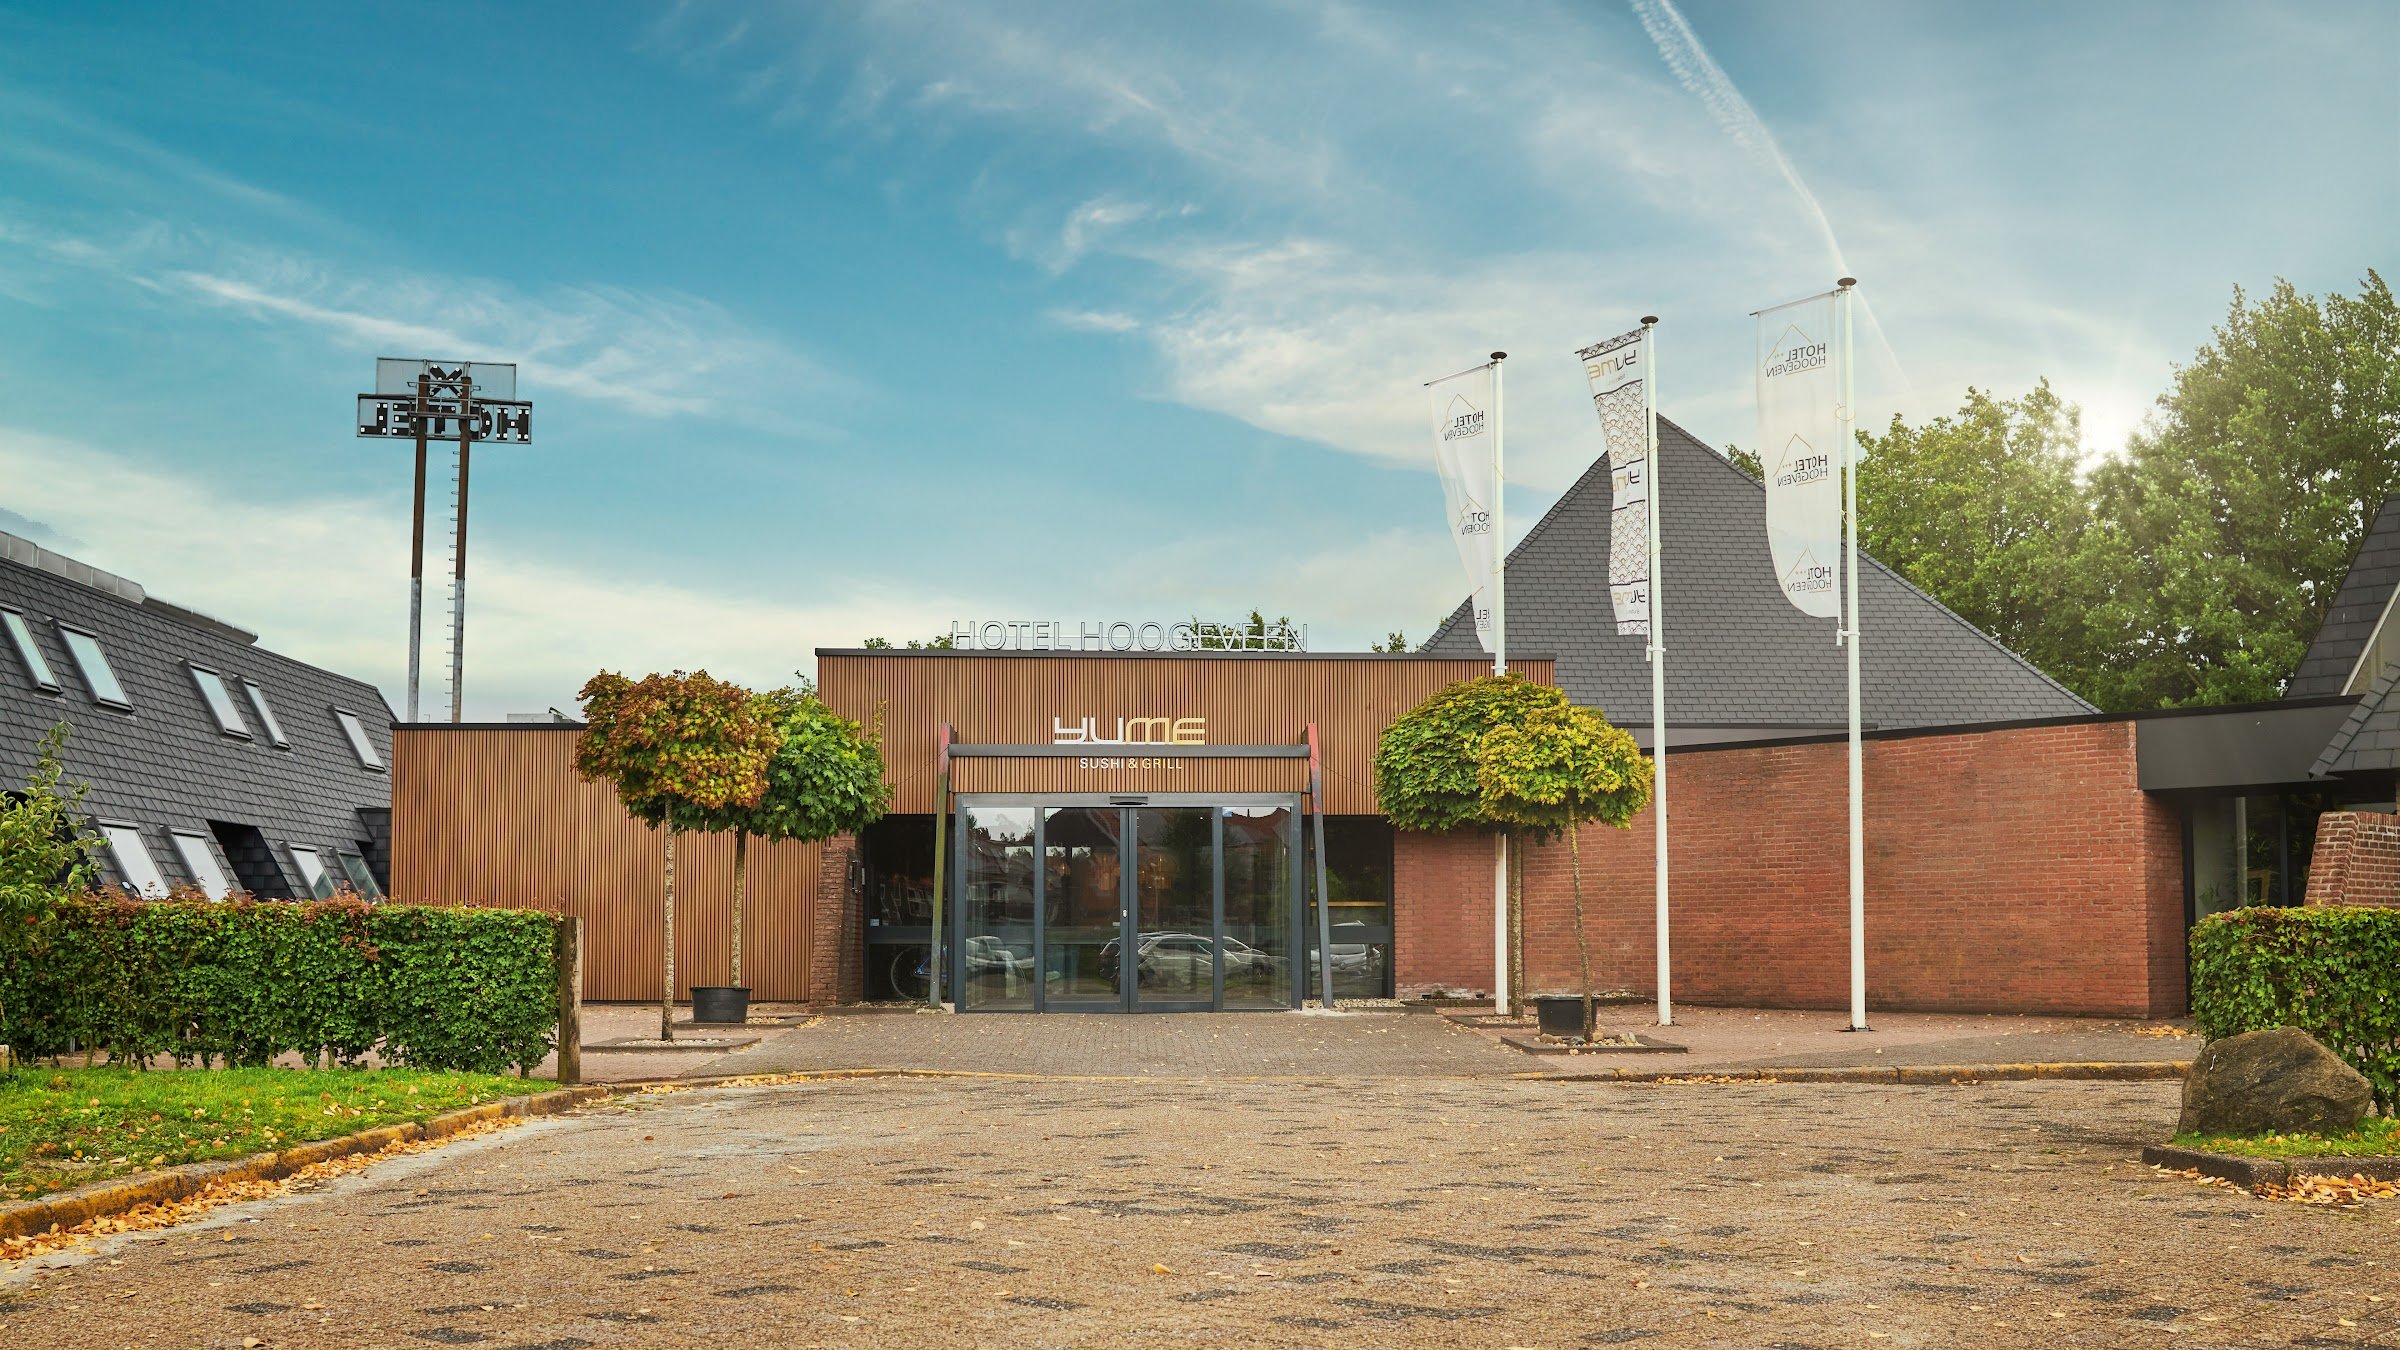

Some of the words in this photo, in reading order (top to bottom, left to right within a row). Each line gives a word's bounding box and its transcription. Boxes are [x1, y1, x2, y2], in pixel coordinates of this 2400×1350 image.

[951, 620, 1071, 650] HOTEL
[1080, 621, 1308, 653] HOOGEVEEN
[1079, 757, 1125, 770] SUSHI
[1128, 757, 1139, 770] &
[1141, 758, 1183, 770] GRILL
